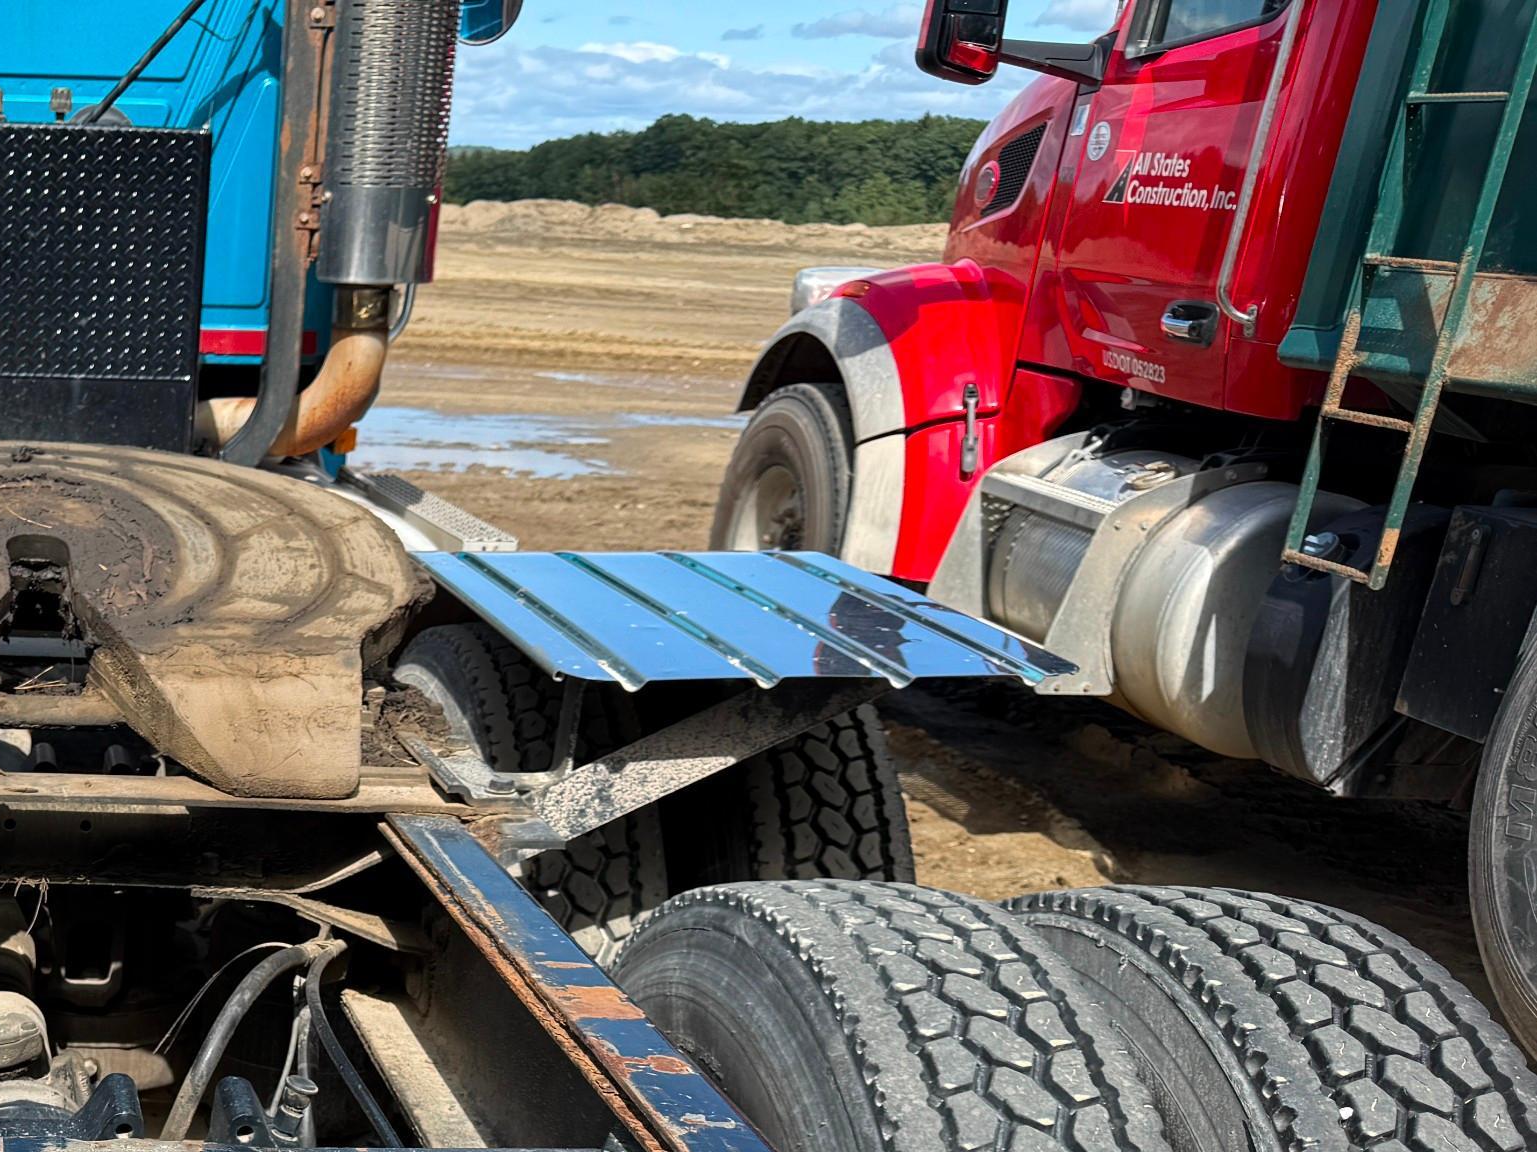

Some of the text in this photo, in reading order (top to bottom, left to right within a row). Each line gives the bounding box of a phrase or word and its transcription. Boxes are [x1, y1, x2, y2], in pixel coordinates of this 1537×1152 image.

[1132, 152, 1191, 178] All States
[1127, 179, 1237, 211] Construction, Inc.
[1102, 349, 1166, 384] USDOT 052823
